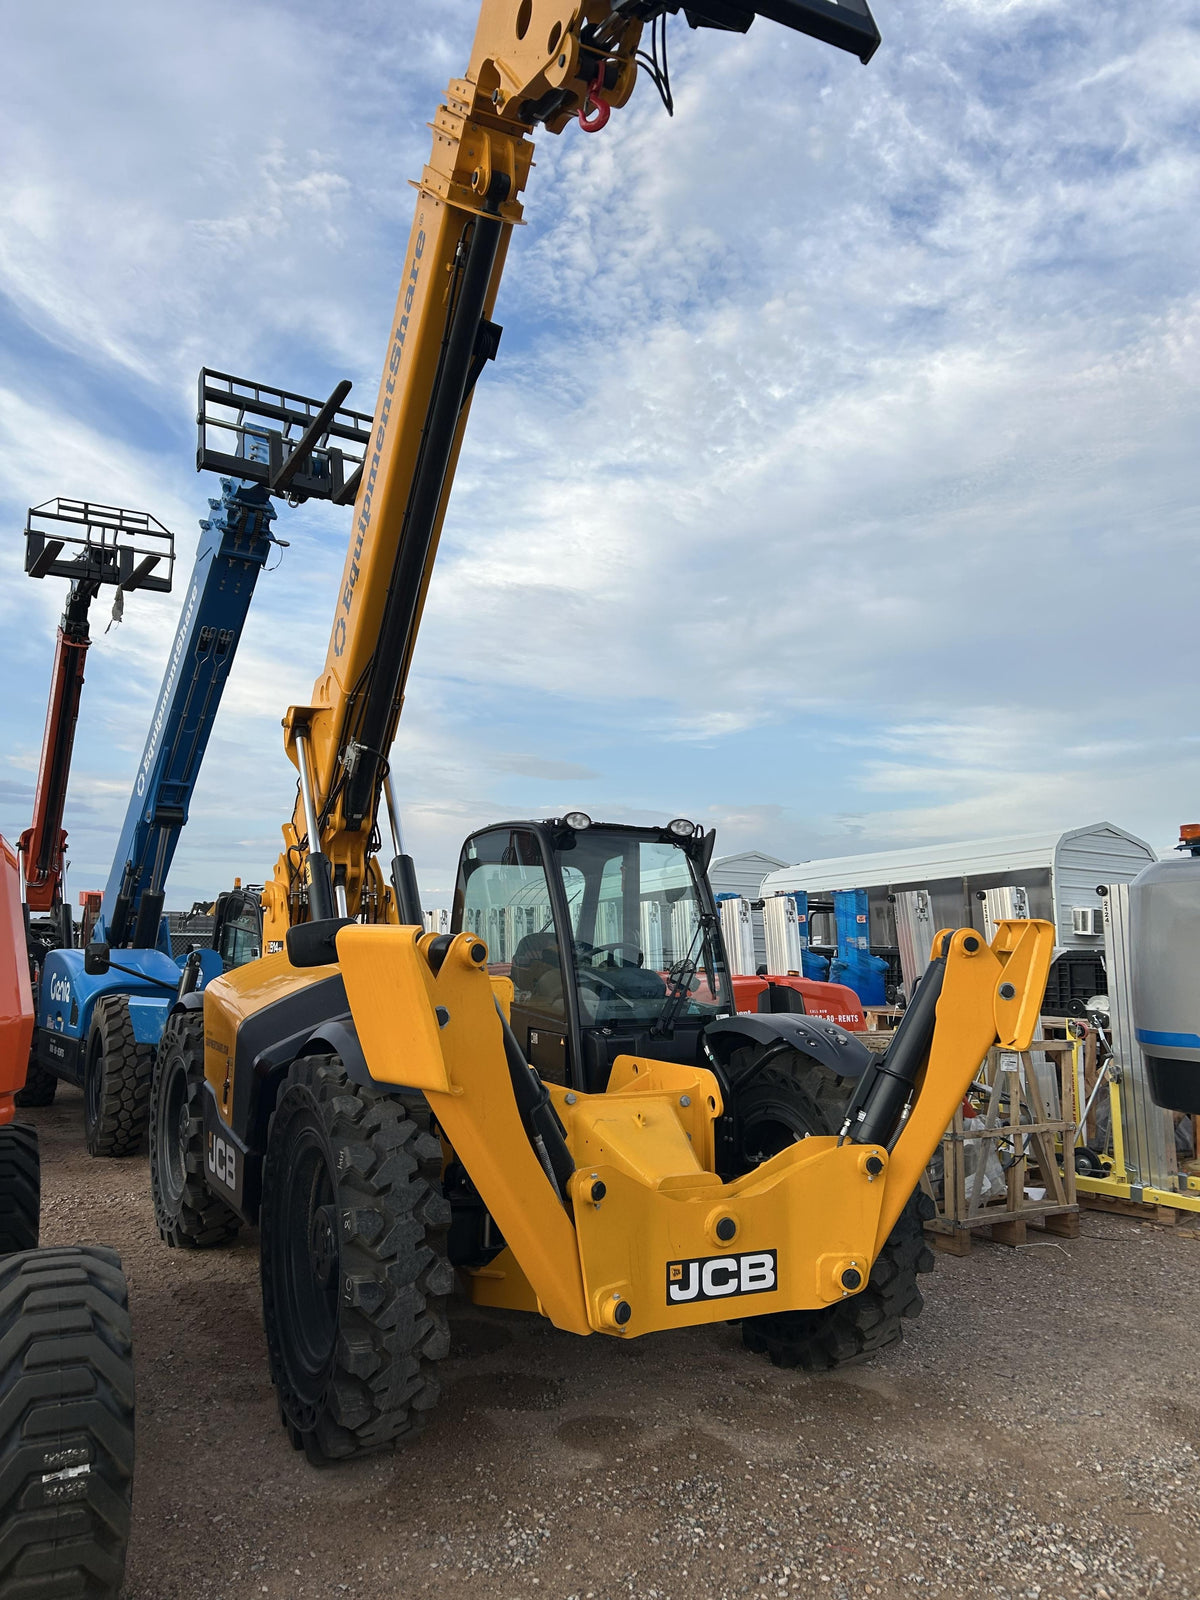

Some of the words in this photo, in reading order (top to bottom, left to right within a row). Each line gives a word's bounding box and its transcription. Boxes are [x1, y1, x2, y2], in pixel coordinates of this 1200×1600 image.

[143, 584, 198, 773] EquipmentShare
[50, 972, 71, 1003] Genie
[208, 1134, 236, 1191] JCB
[669, 1253, 776, 1301] JCB
